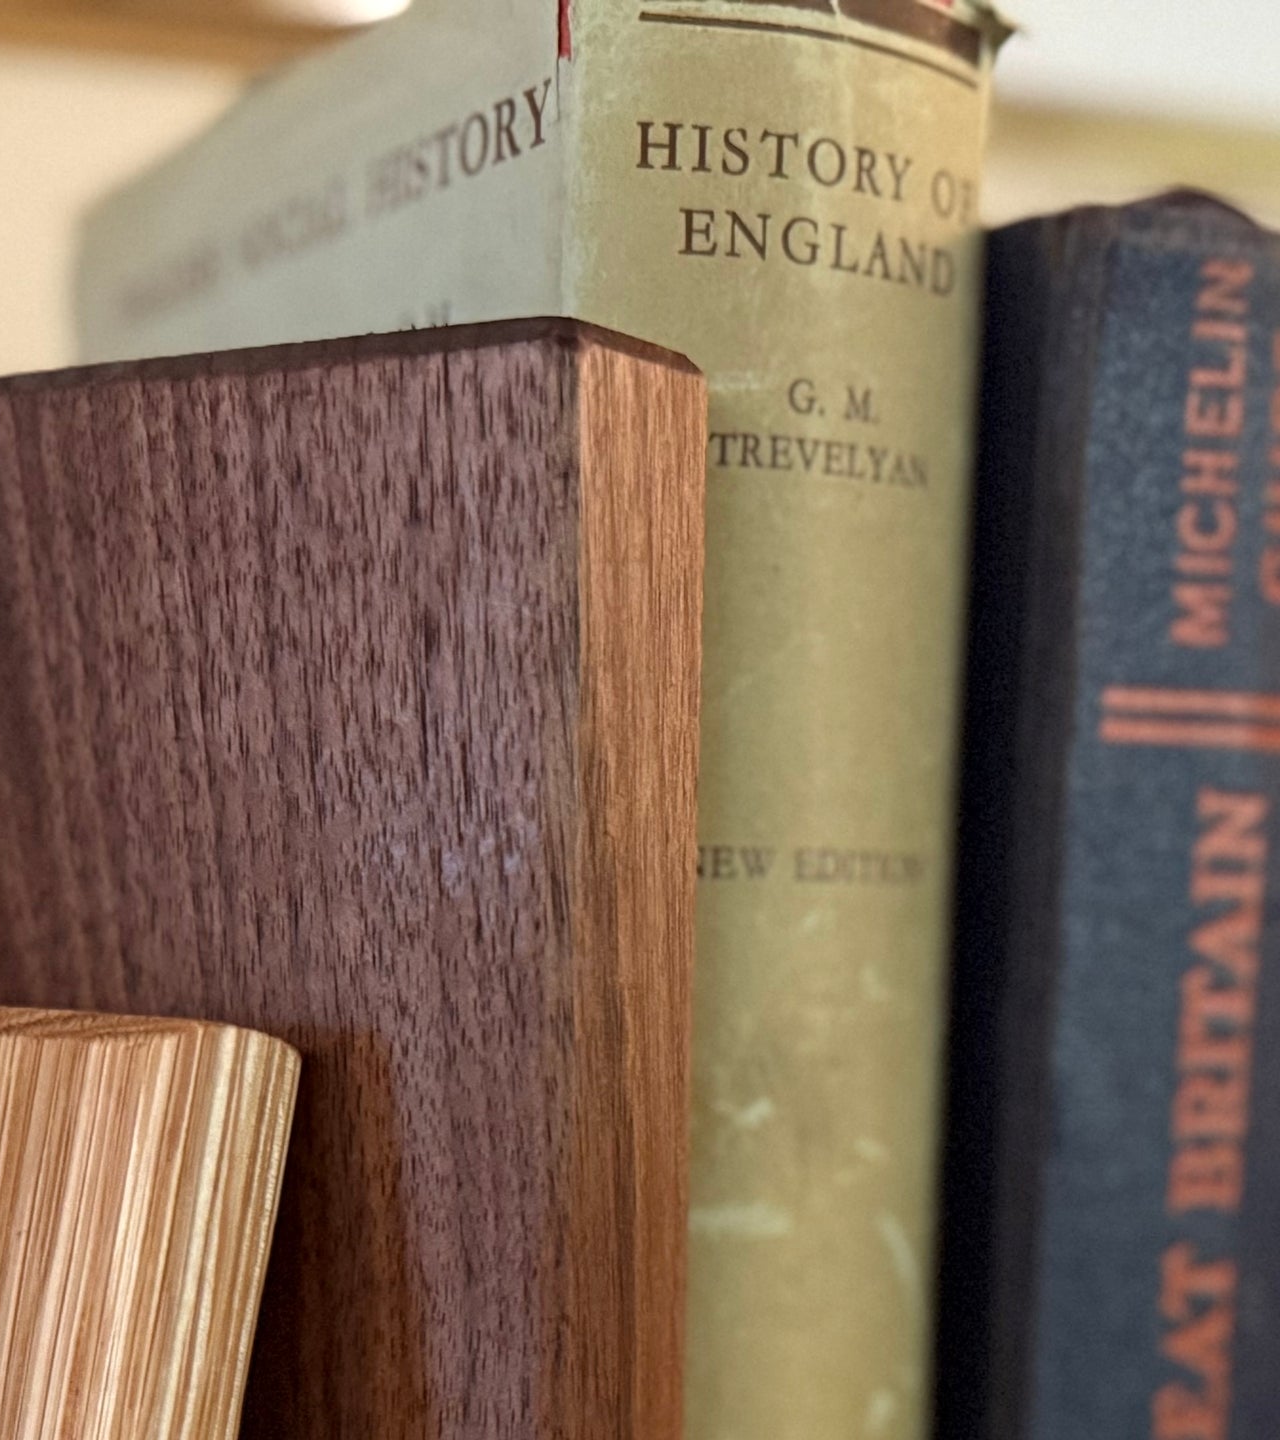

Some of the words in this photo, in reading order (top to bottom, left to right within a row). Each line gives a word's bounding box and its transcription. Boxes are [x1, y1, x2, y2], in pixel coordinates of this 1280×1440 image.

[362, 78, 552, 220] HISTORY
[635, 120, 913, 202] HISTORY
[677, 206, 956, 298] ENGLAND
[787, 378, 825, 417] G.
[843, 385, 880, 425] M.
[708, 431, 929, 488] TREVELYAN
[1168, 256, 1256, 650] MICHELIN
[1166, 786, 1272, 1215] BRITAIN
